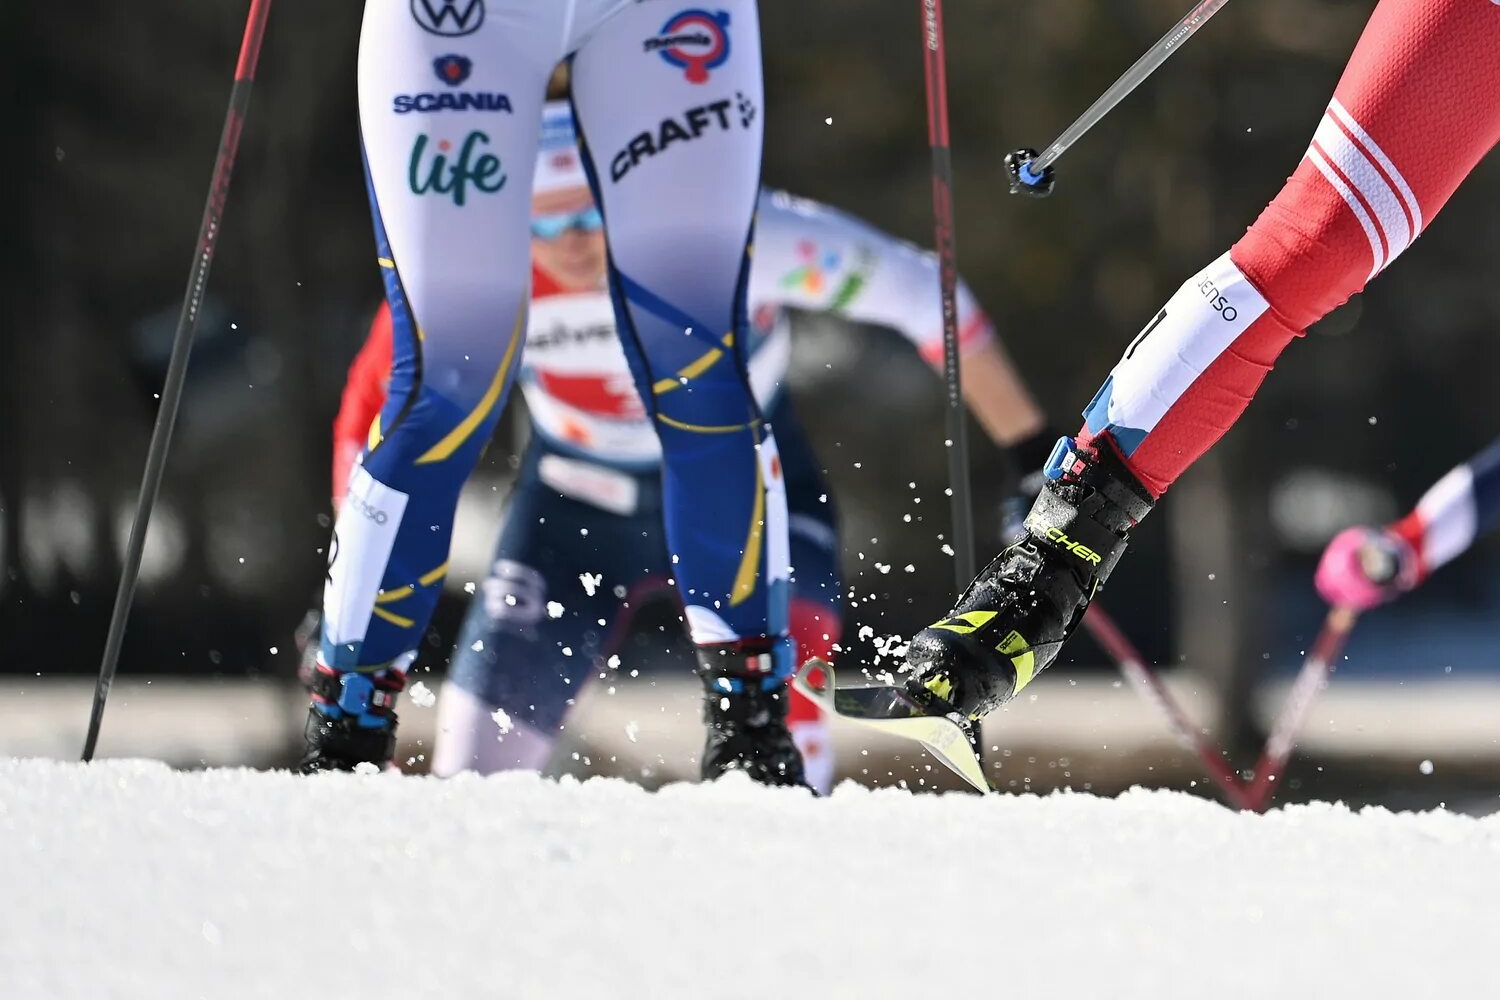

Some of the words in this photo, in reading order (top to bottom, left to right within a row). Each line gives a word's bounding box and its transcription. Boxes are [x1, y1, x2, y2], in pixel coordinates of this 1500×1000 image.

[643, 31, 712, 53] Thermia
[393, 92, 513, 114] SCANIA
[609, 99, 731, 184] CRAFT
[407, 128, 507, 207] life
